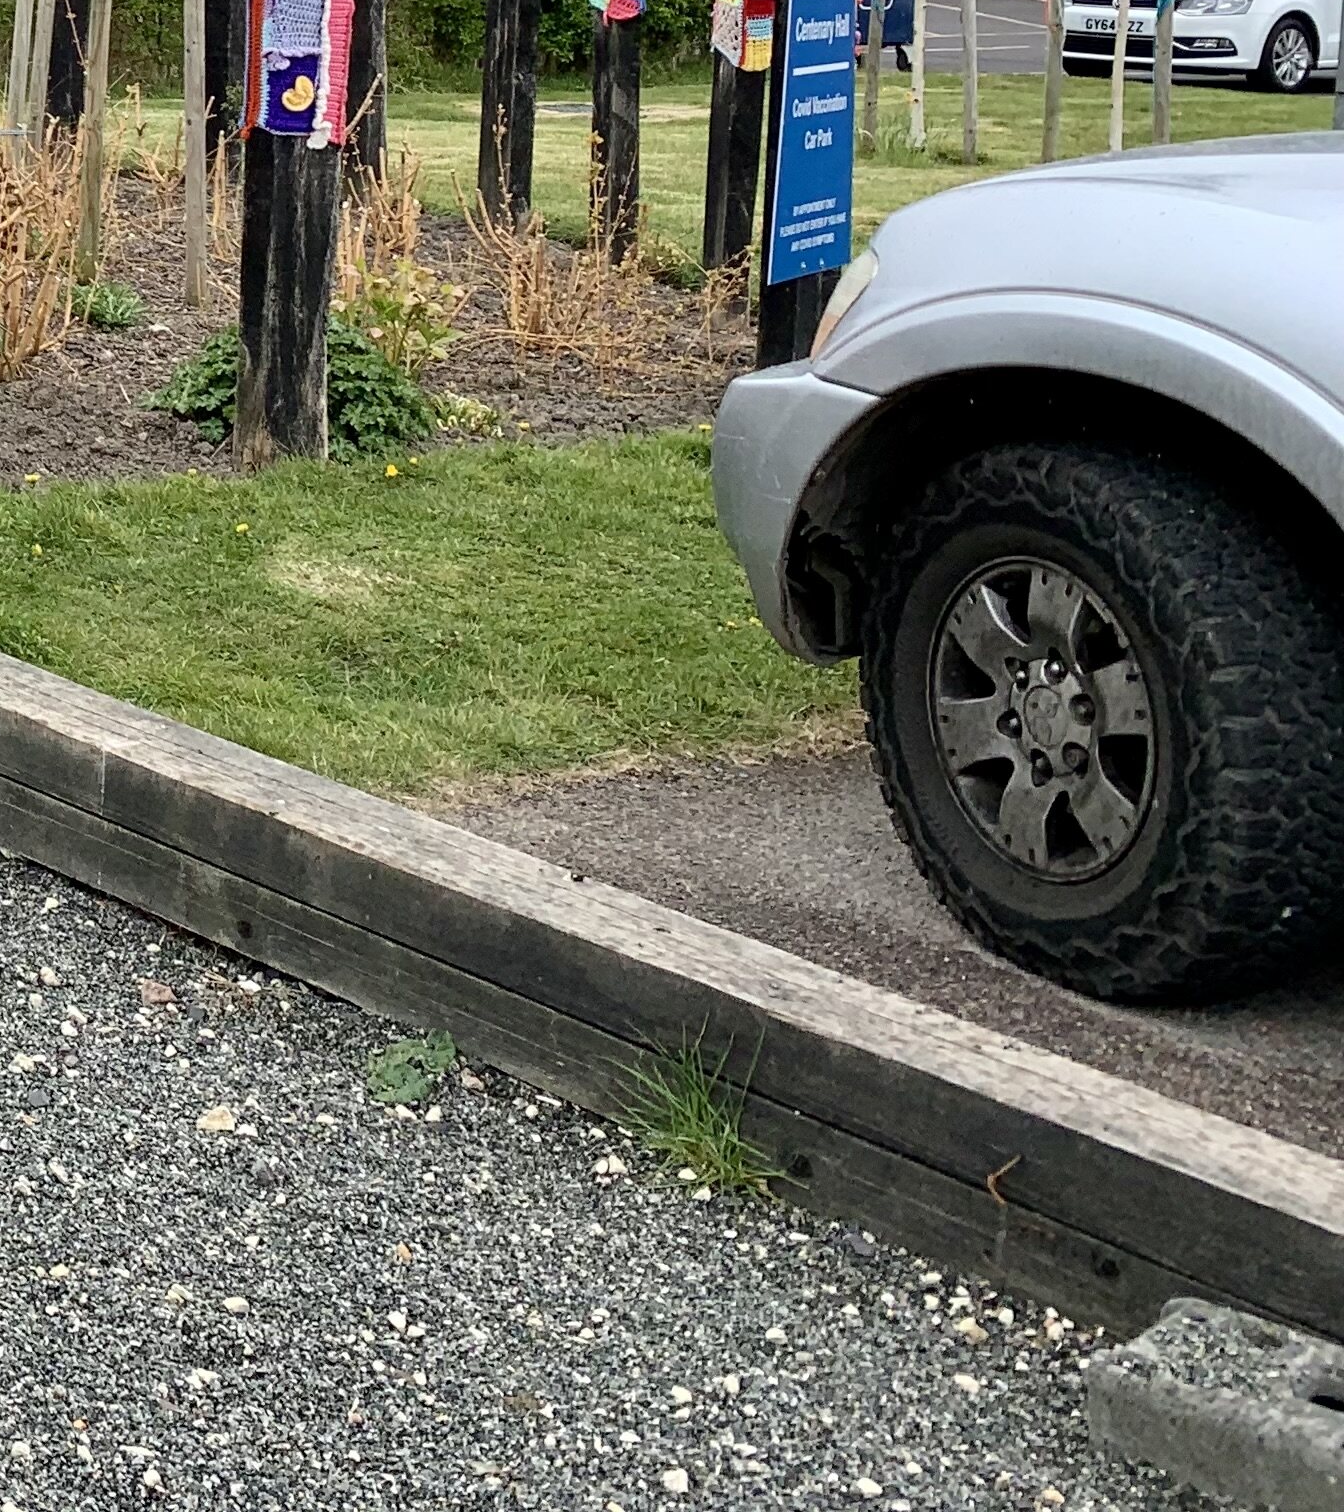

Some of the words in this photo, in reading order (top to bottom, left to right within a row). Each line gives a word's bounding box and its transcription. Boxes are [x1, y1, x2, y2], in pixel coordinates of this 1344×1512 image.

[796, 17, 834, 45] Centenary
[835, 13, 850, 38] Hall
[1086, 18, 1116, 30] GY64
[792, 97, 812, 118] Covid
[805, 130, 817, 150] Car
[817, 127, 833, 148] Park
